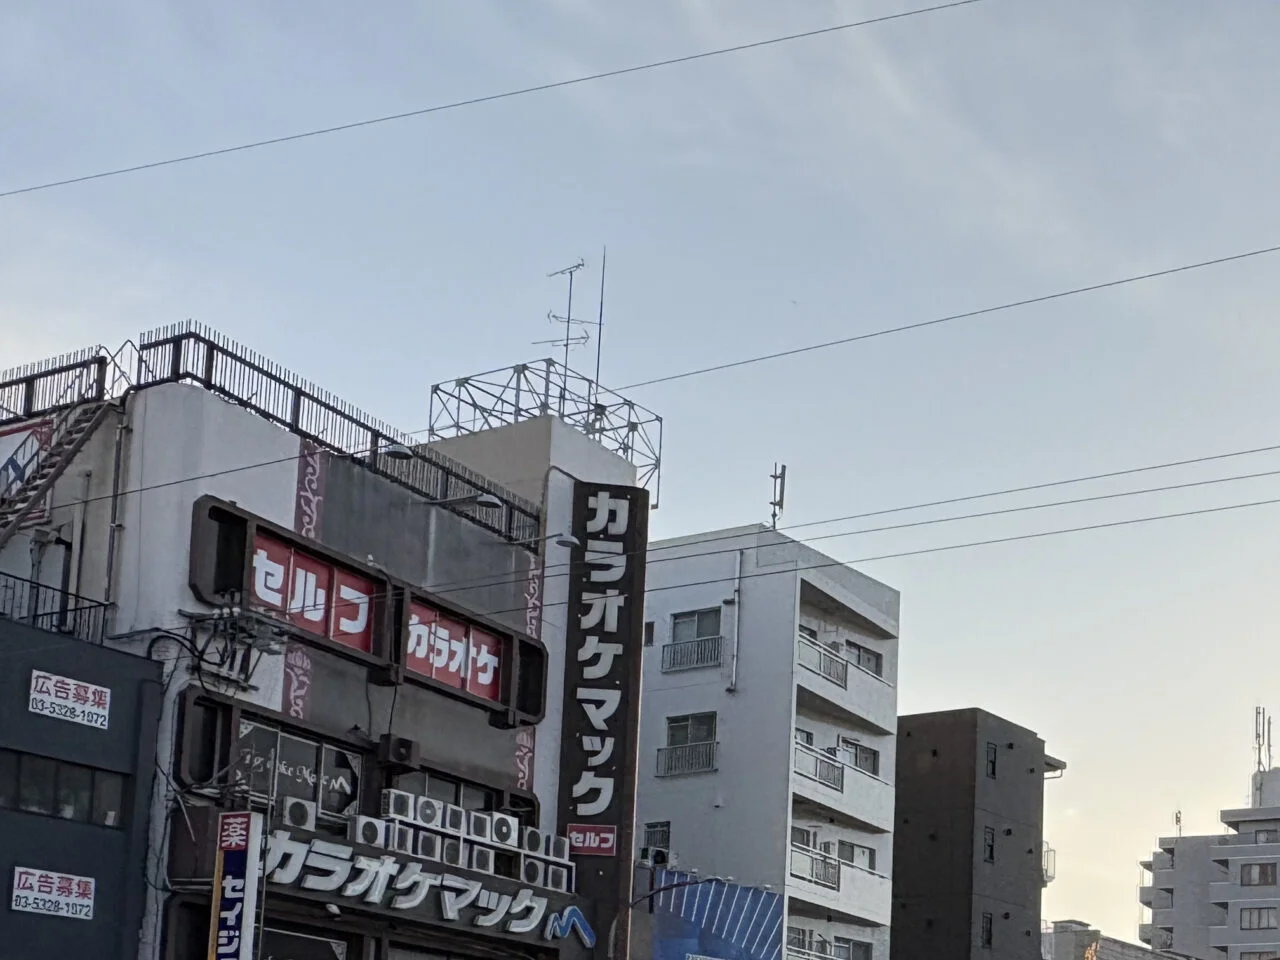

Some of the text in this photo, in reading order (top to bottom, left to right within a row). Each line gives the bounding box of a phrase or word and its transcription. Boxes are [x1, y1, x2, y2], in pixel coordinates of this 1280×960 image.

[253, 549, 499, 686] セルフ カラオケ
[571, 490, 631, 817] カラオケマック
[33, 674, 109, 710] 広告募集
[220, 817, 248, 850] 薬
[569, 829, 615, 850] セルフ
[17, 871, 92, 900] 広告募集
[260, 829, 548, 934] カラオケマック
